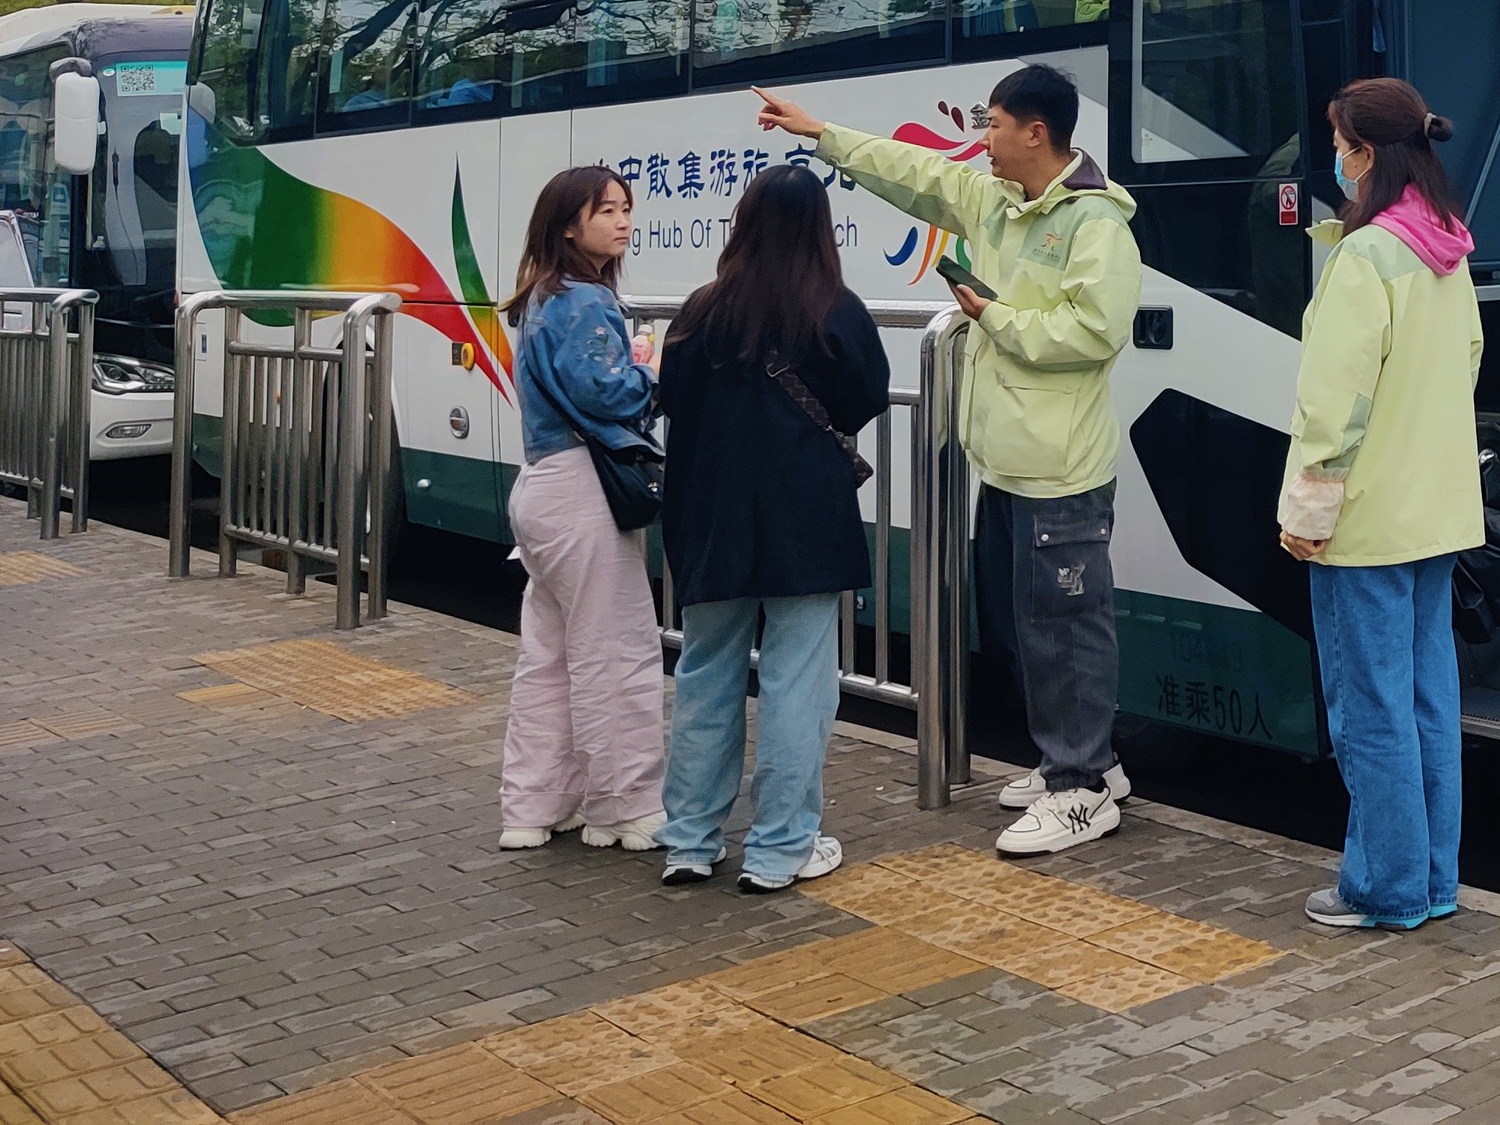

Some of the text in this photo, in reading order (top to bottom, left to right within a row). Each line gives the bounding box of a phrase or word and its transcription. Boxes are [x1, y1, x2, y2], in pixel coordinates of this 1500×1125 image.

[649, 220, 683, 249] Hub
[690, 219, 712, 249] Of
[1156, 675, 1273, 740] 准乘50人
